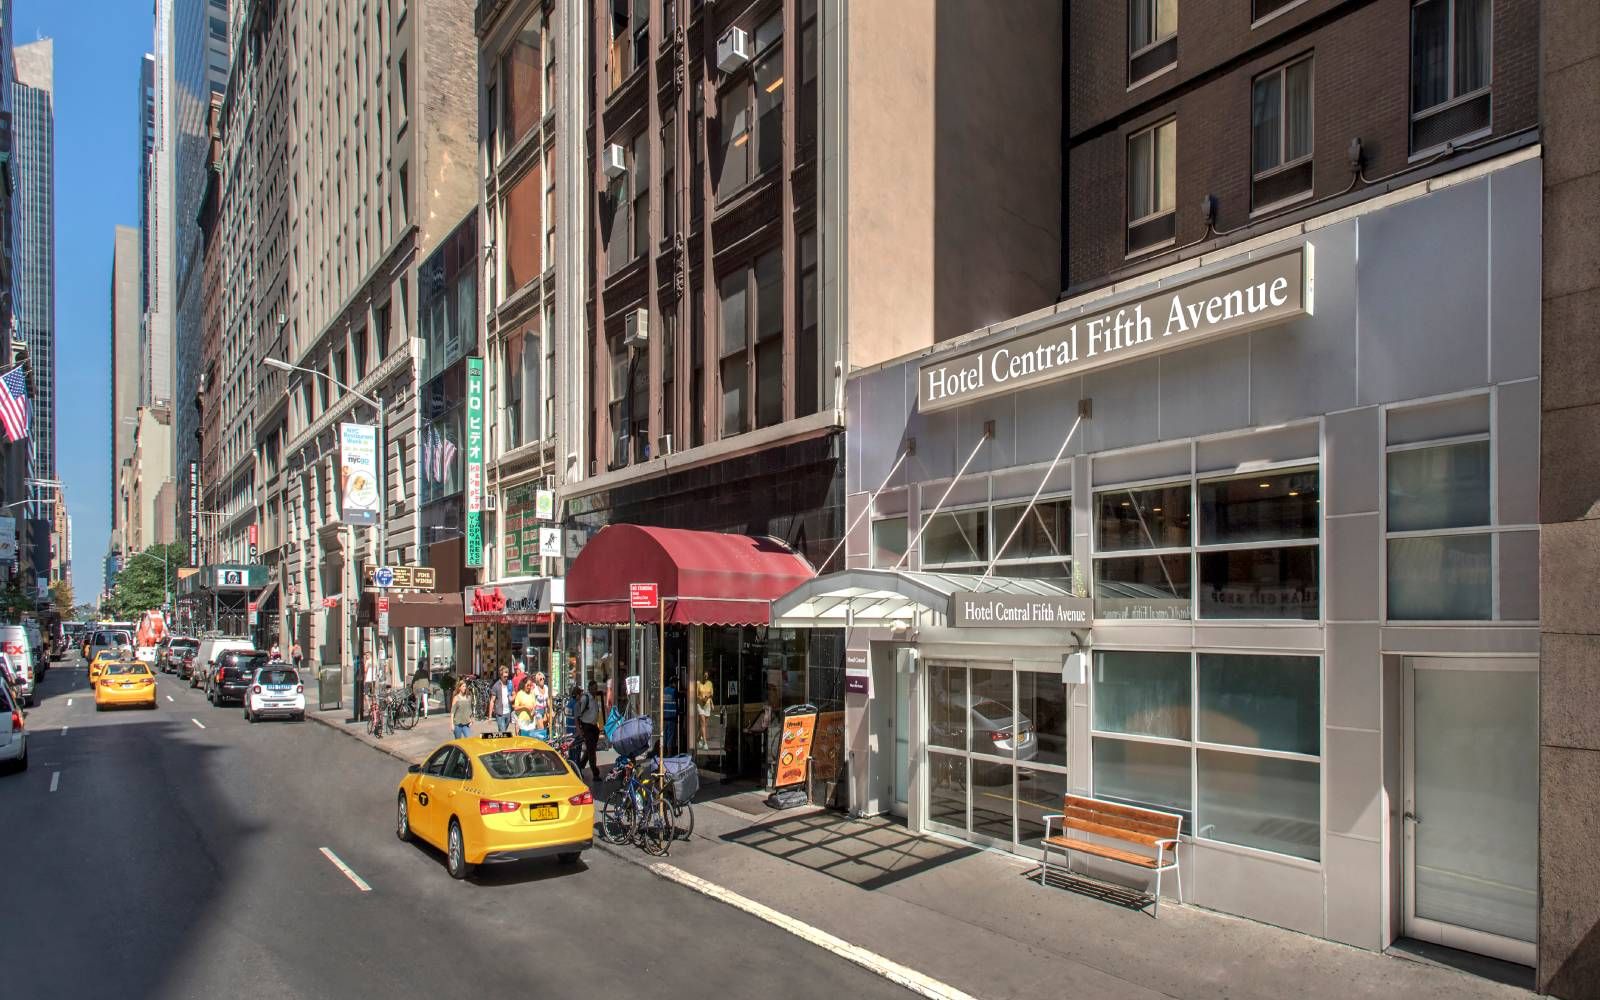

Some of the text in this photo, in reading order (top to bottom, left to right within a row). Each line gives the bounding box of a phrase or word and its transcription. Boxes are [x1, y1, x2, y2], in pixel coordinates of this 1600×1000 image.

[927, 276, 1288, 402] Hotel Central Fifth Avenue
[964, 602, 1086, 621] Hotel Central Fifth Avenue
